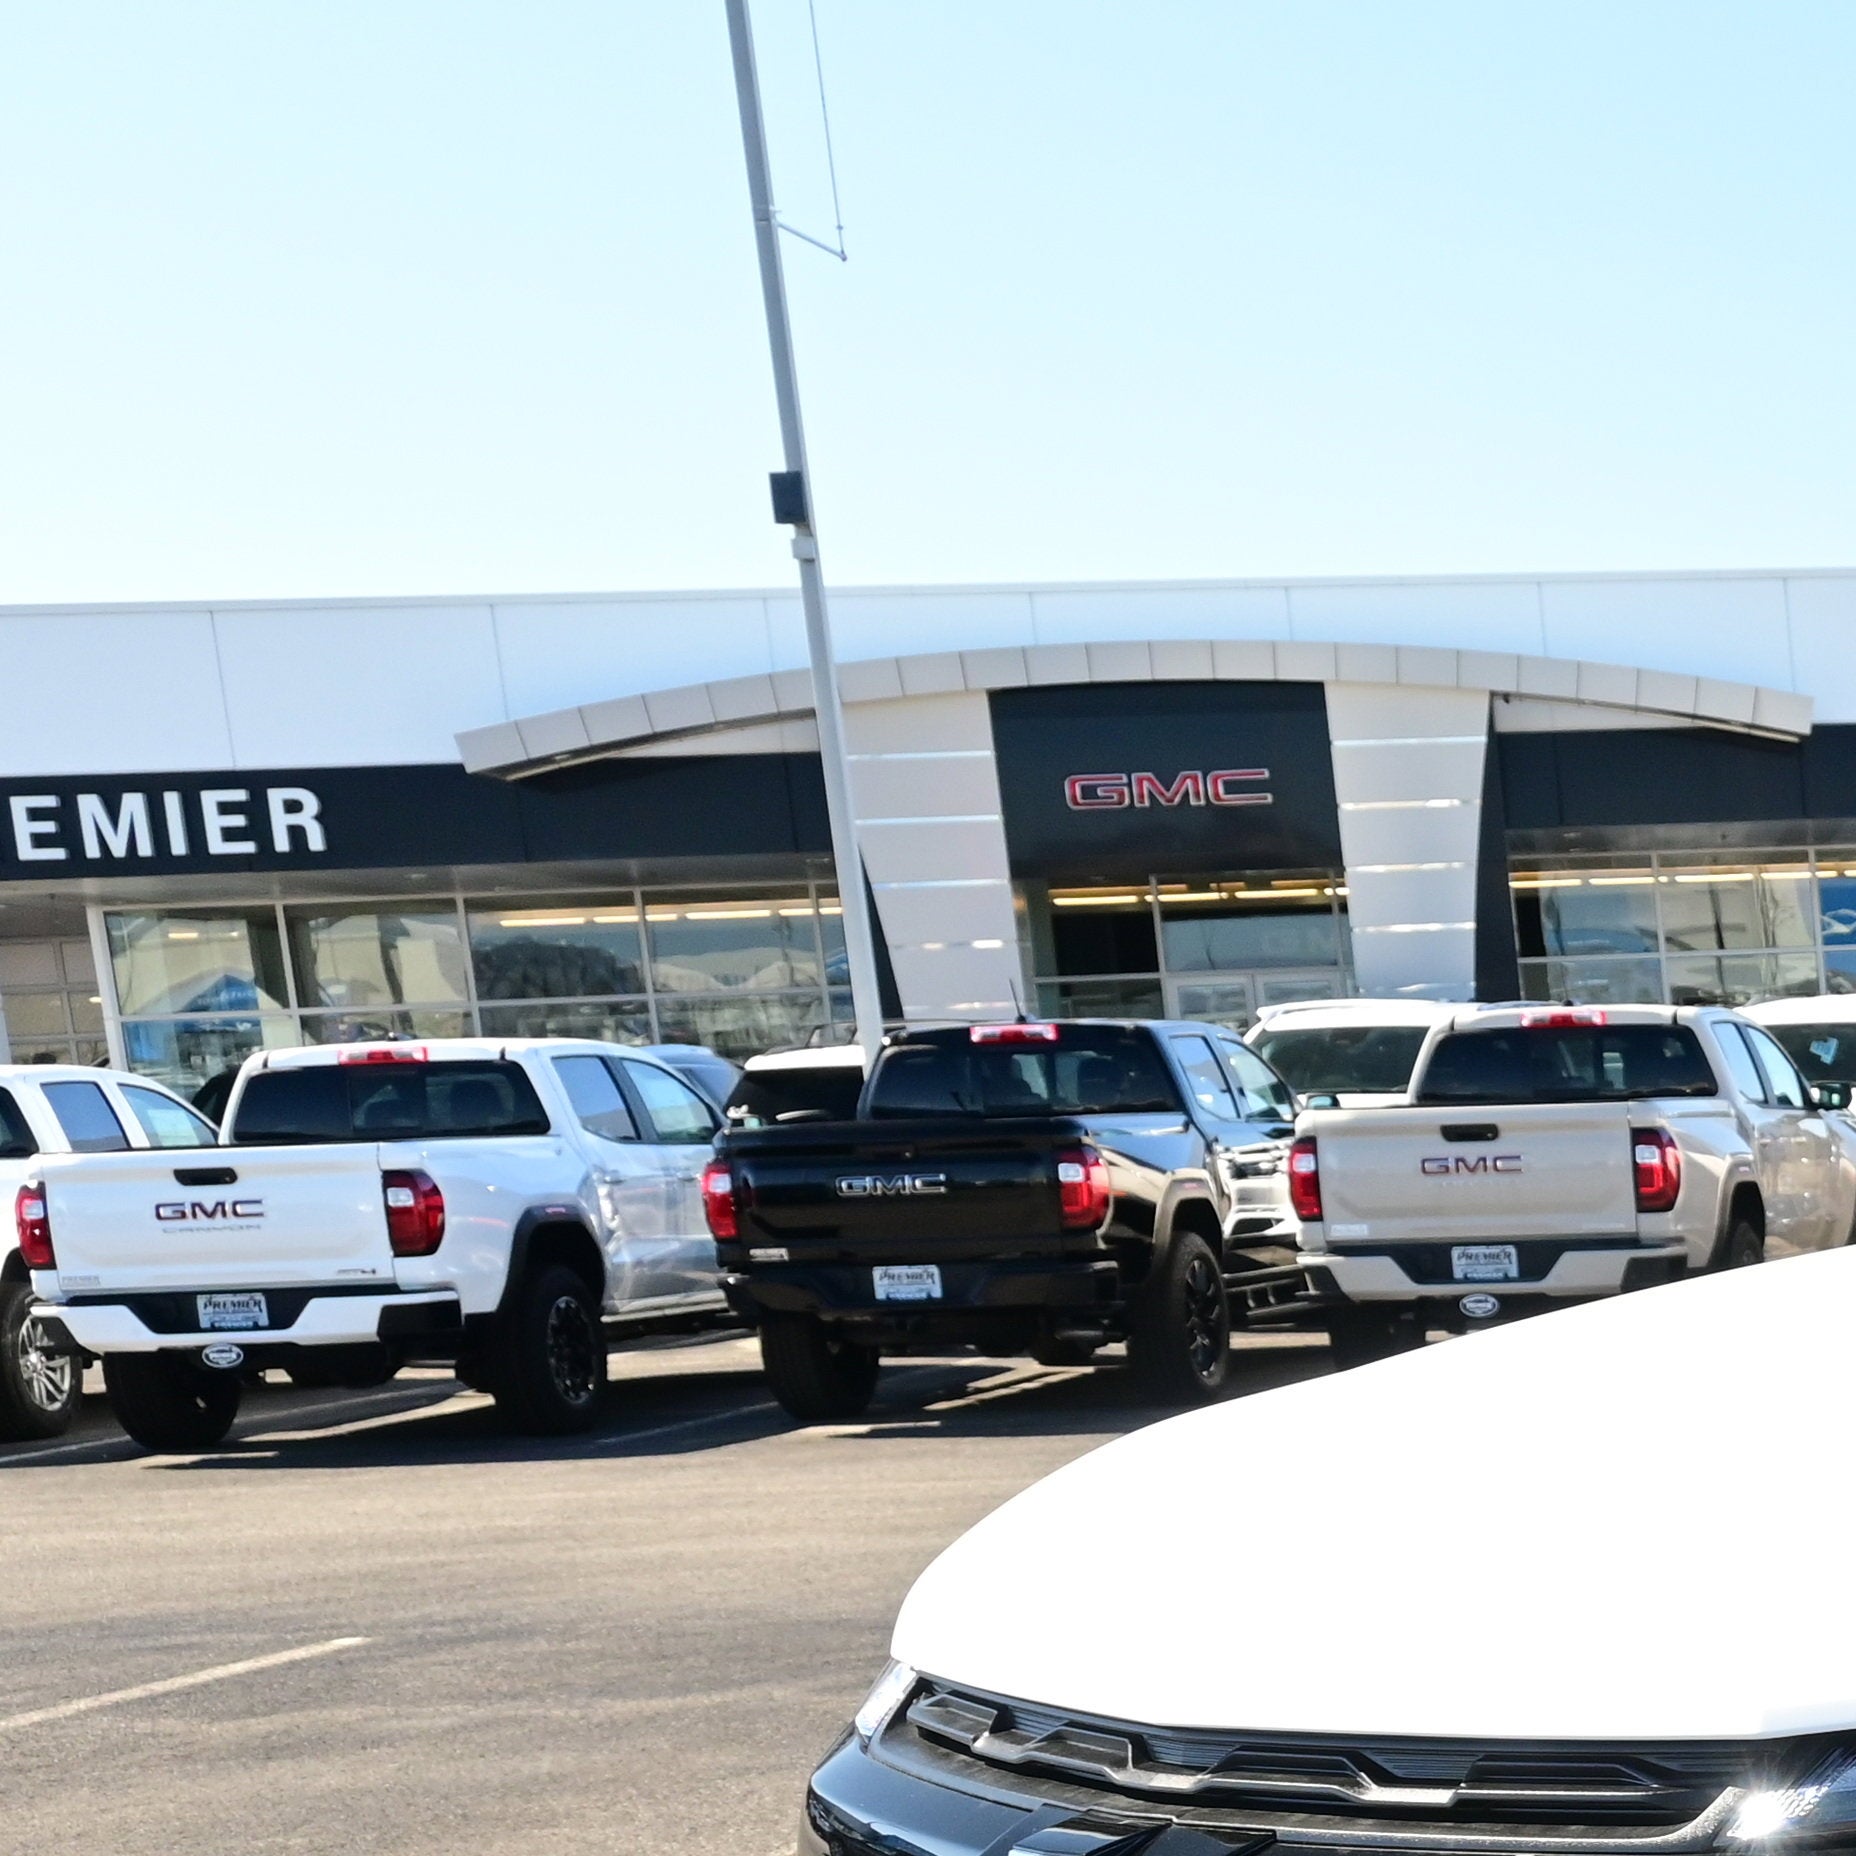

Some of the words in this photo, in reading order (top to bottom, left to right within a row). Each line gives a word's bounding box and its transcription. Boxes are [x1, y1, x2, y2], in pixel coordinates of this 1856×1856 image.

[1064, 768, 1274, 810] GMC
[9, 786, 328, 861] EMIER
[1421, 1155, 1523, 1175] GMC
[835, 1173, 947, 1197] GMC
[155, 1199, 265, 1221] GMC
